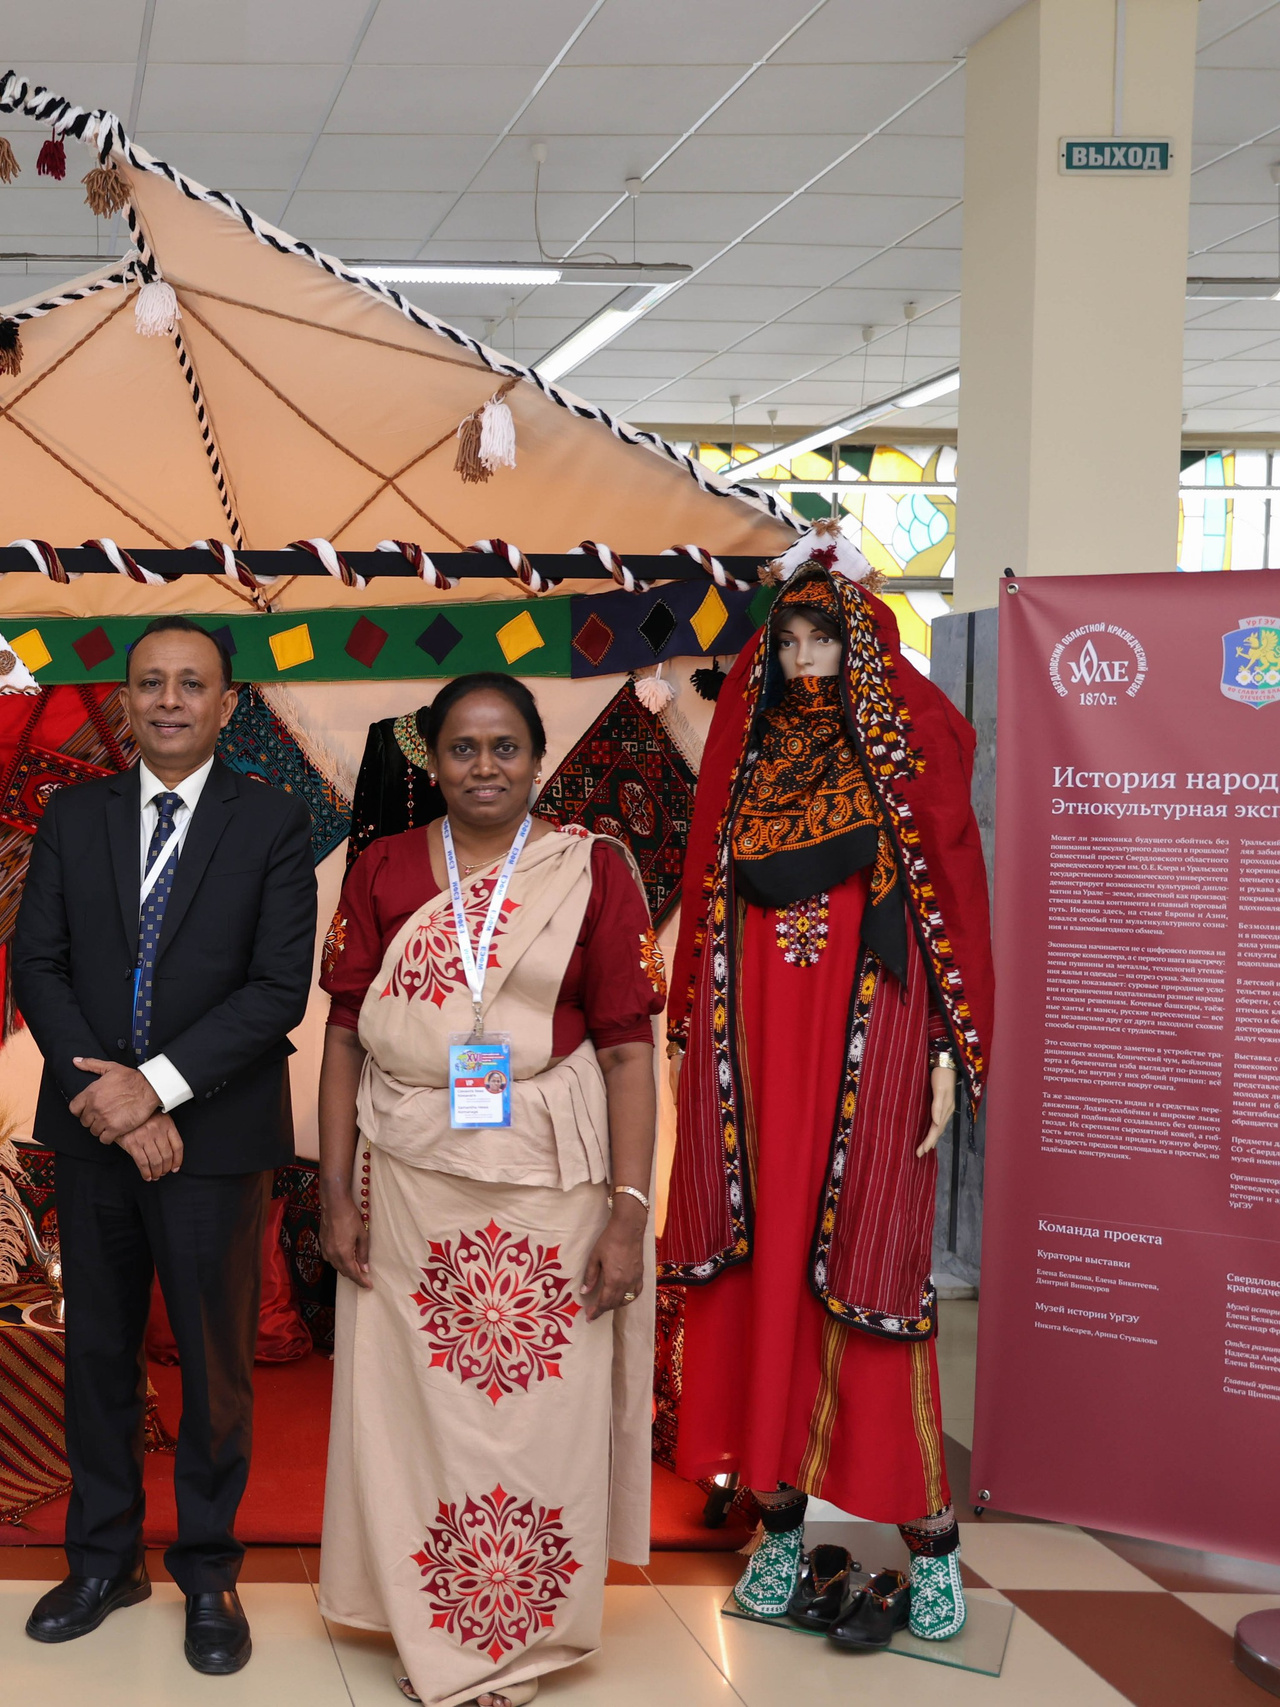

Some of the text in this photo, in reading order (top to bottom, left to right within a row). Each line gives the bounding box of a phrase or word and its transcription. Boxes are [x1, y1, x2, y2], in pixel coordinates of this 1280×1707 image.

[1072, 147, 1161, 170] ВЫХОД
[1049, 622, 1148, 697] СВЕРДЛОВСКИЙ ОБЛАСТНОЙ КРАЕВЕДЧЕСКИЙ МУЗЕЙ
[1051, 766, 1279, 795] История народ
[1051, 797, 1227, 820] Этнокультурная
[1038, 1219, 1162, 1245] Команда проекта
[1036, 1248, 1130, 1268] Кураторы выставки
[1034, 1301, 1140, 1324] Музей истории УрГЭУ
